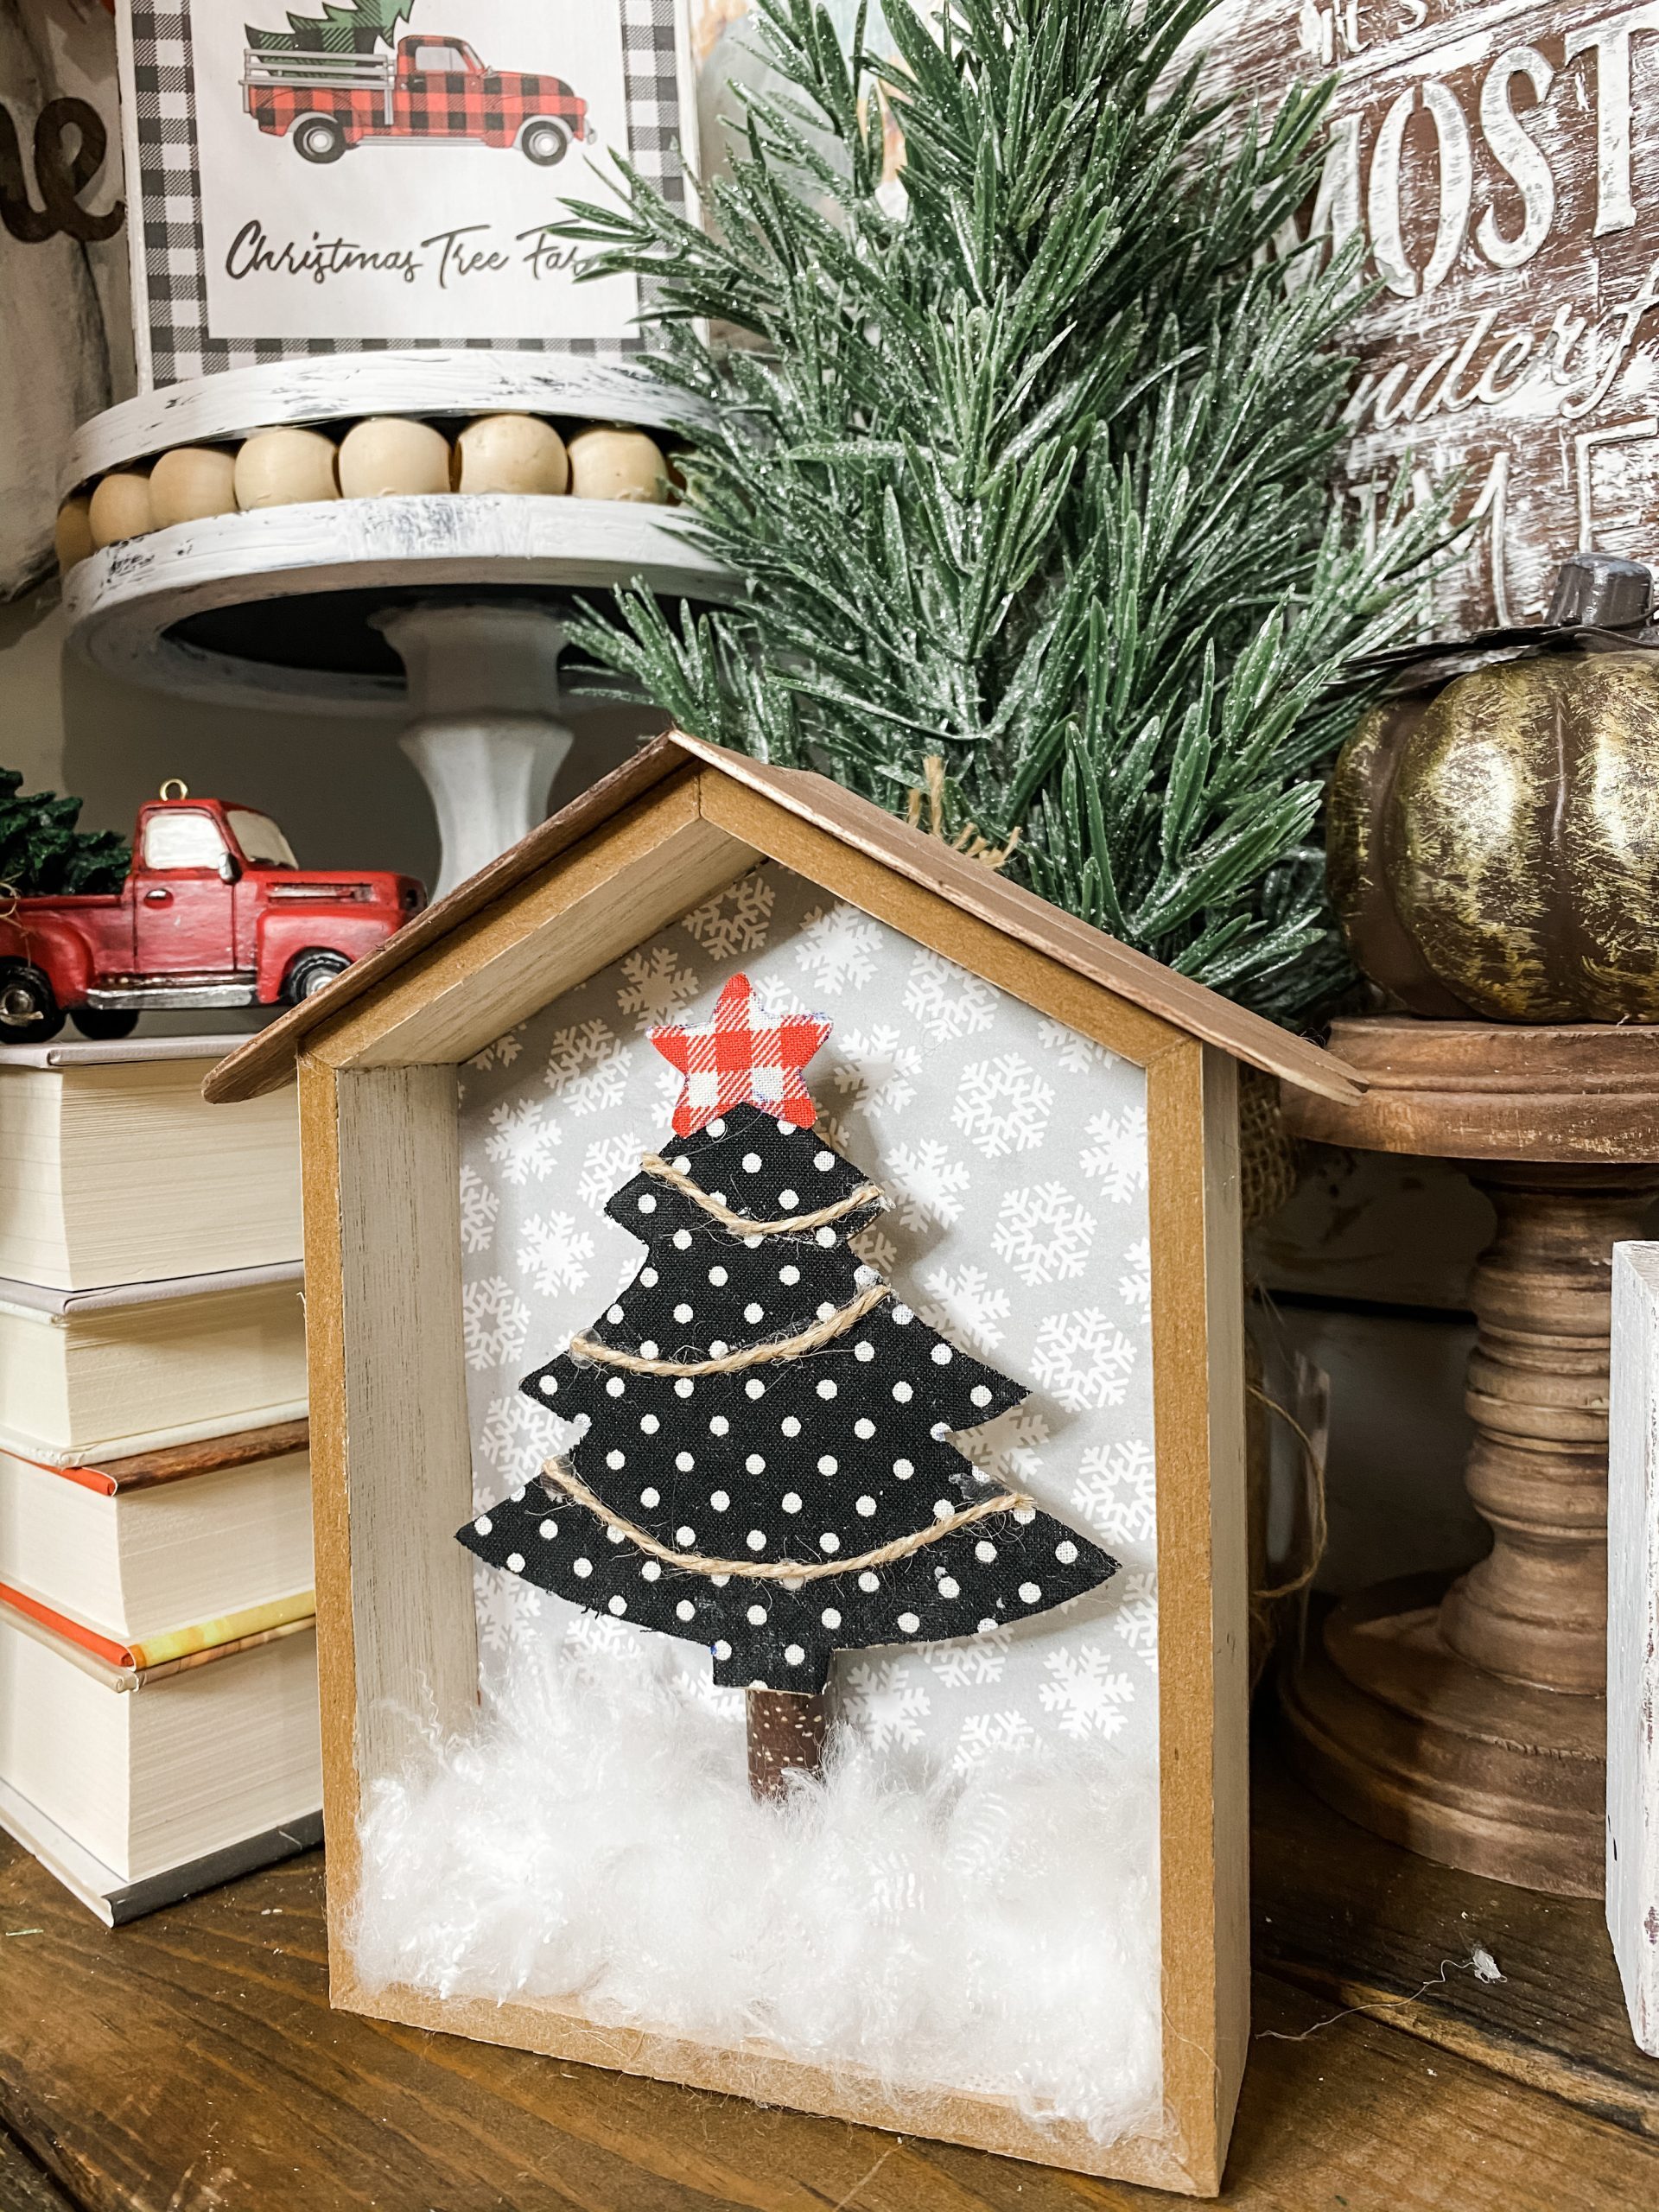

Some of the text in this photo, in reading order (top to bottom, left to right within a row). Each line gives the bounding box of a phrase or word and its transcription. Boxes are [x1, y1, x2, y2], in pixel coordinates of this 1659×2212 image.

[226, 218, 589, 289] Christmas Tree Far
